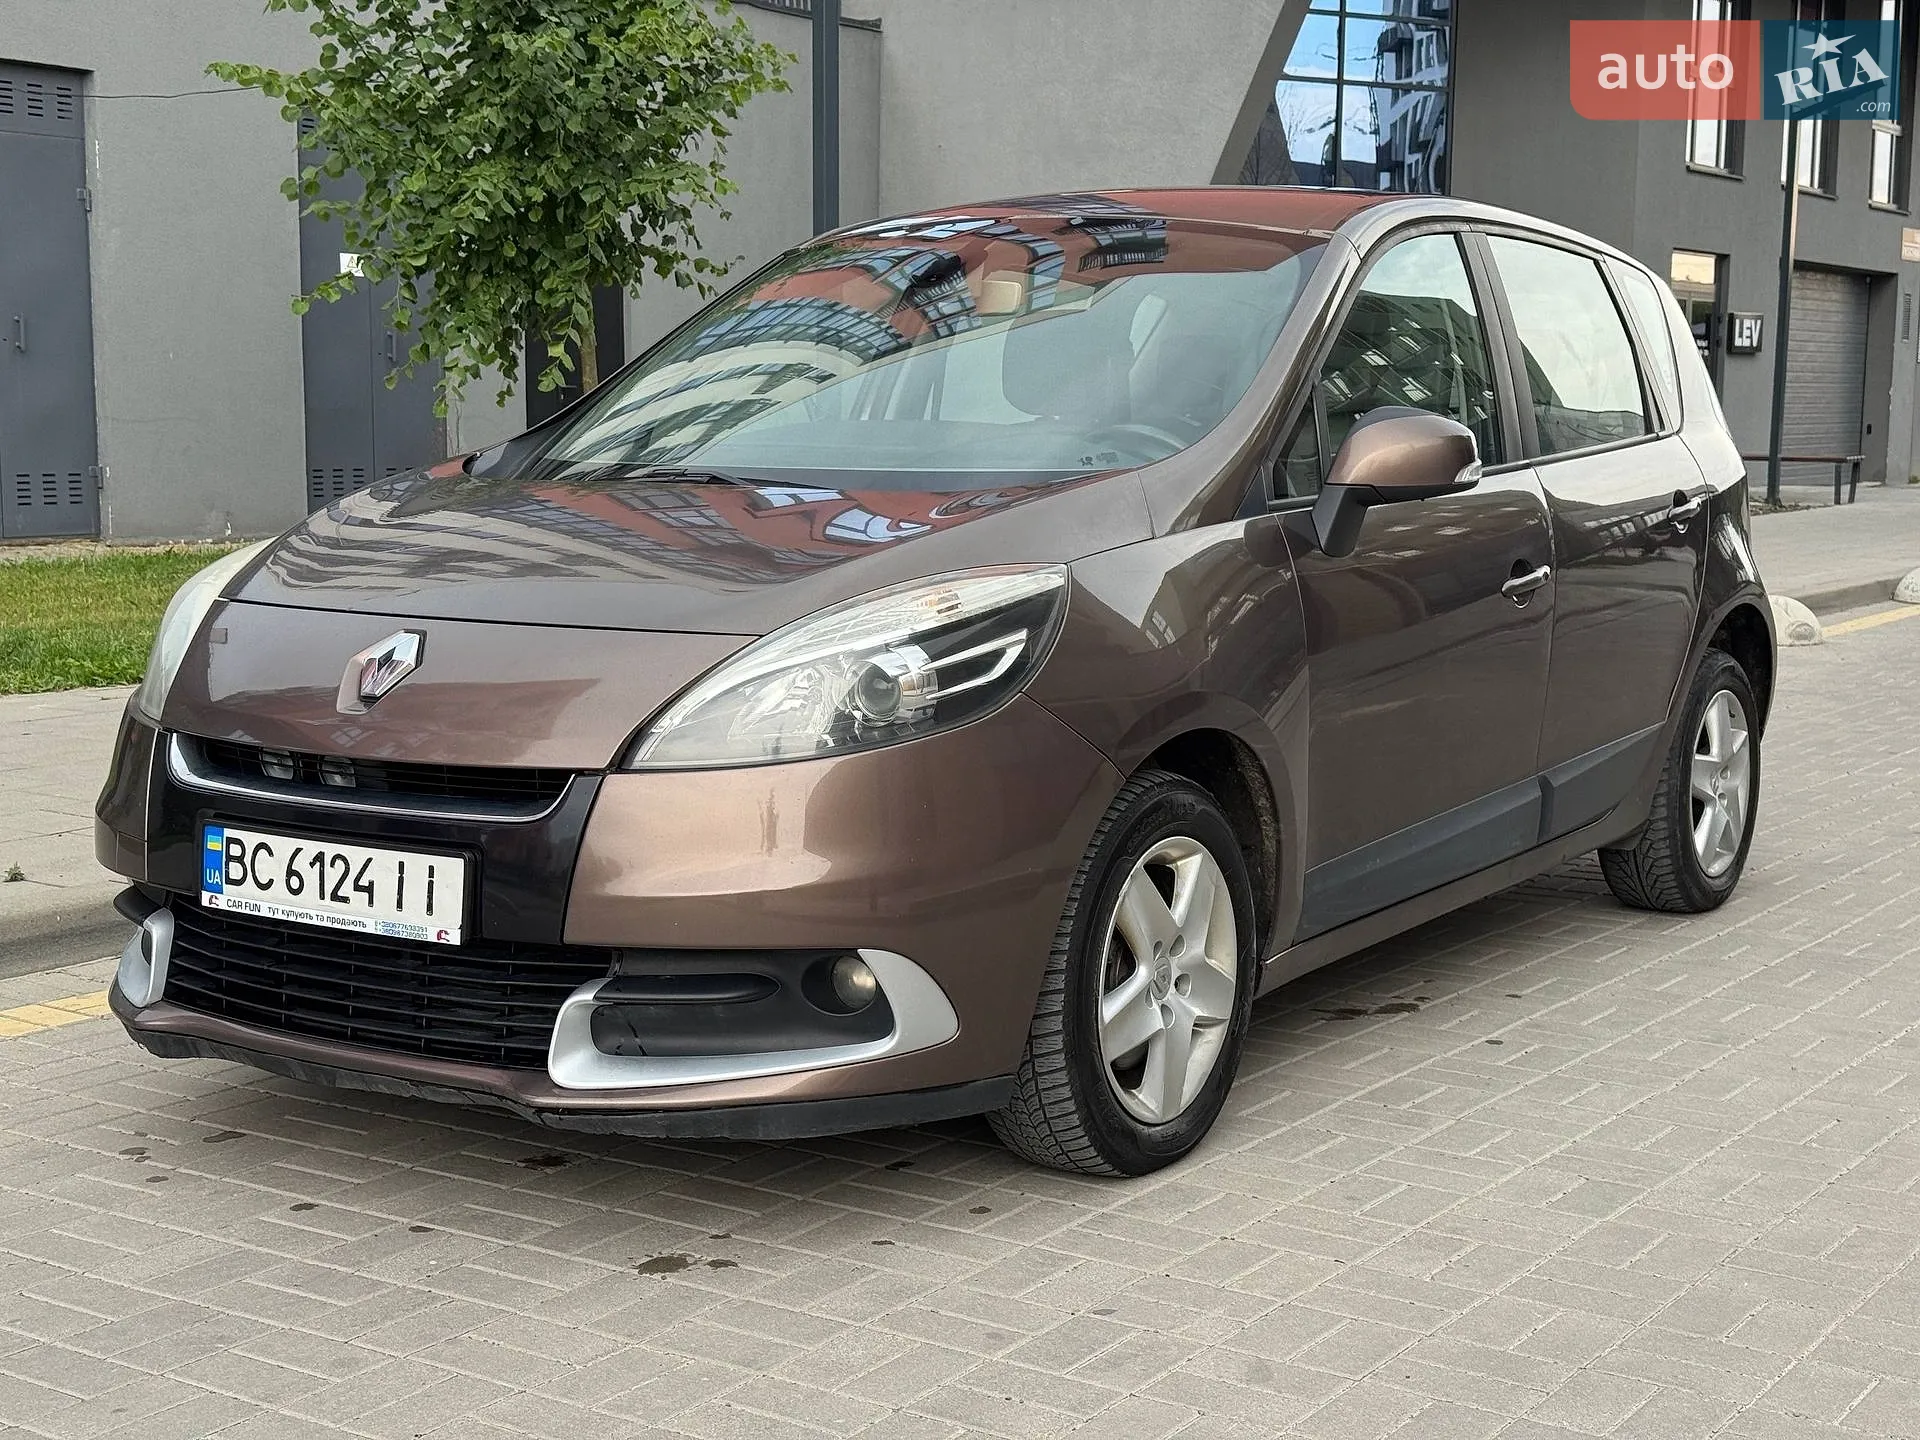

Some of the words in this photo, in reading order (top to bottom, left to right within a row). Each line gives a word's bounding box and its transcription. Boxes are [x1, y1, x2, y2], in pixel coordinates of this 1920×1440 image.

[1734, 318, 1762, 347] LEV
[207, 868, 222, 886] UA
[225, 836, 274, 891] BC
[285, 847, 374, 907] 6124
[226, 898, 243, 910] CAR
[244, 902, 261, 913] FUN
[267, 906, 279, 916] тут
[281, 909, 314, 921] купують
[315, 914, 325, 922] та
[326, 915, 367, 929] продають
